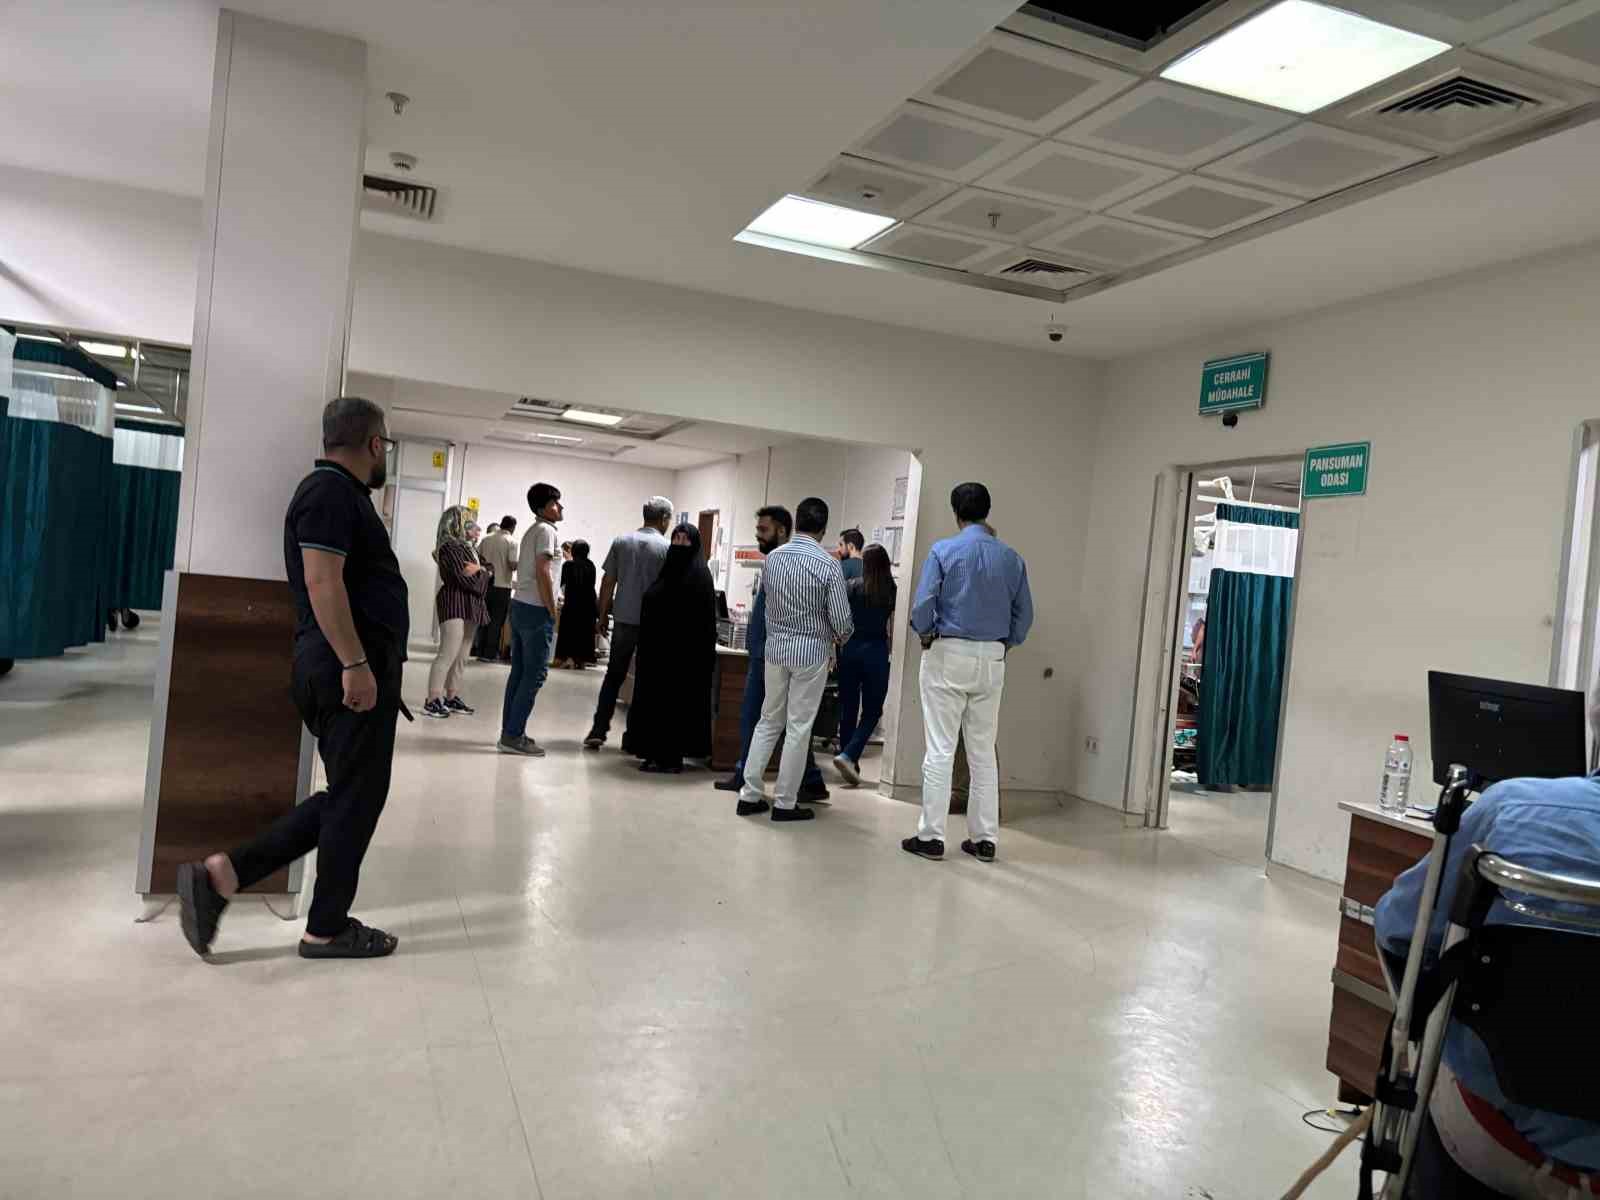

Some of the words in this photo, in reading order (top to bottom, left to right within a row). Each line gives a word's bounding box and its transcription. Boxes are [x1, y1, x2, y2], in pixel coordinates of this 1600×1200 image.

[1208, 384, 1254, 402] MÜDAHALE
[1310, 454, 1363, 472] PANSUMAN
[1320, 472, 1349, 487] ODASI
